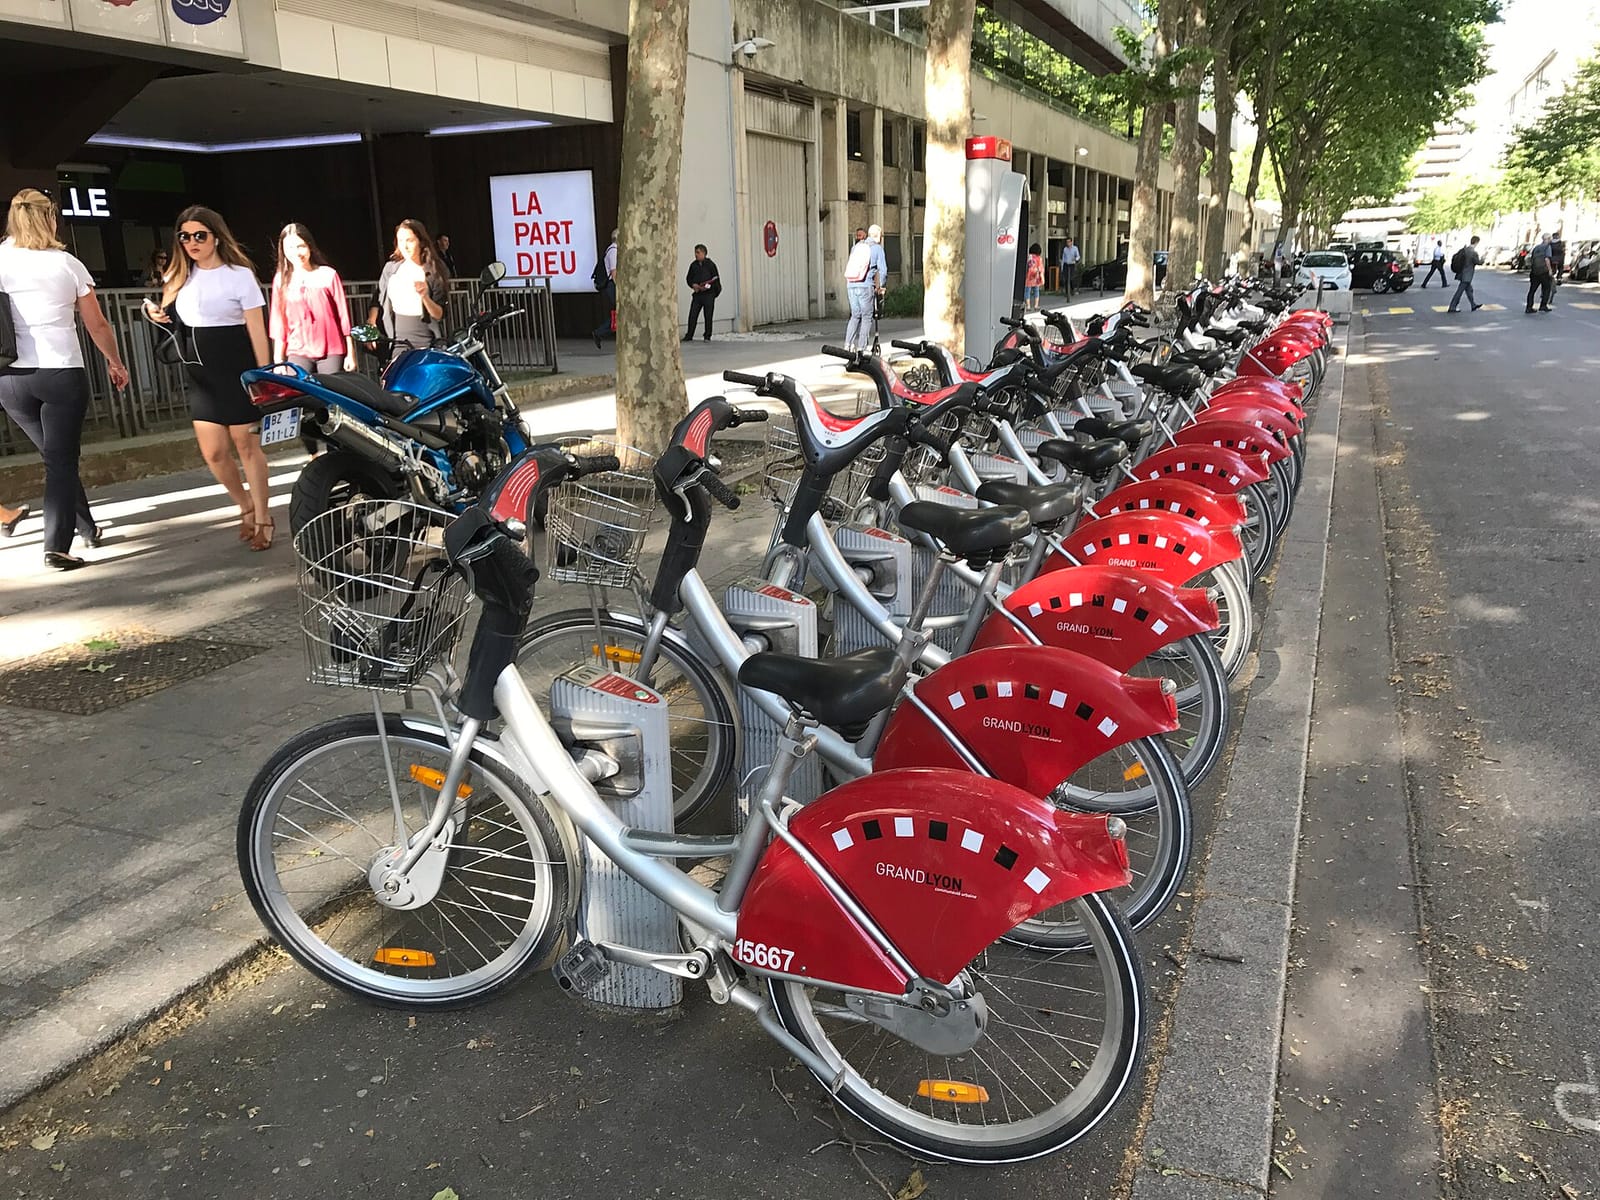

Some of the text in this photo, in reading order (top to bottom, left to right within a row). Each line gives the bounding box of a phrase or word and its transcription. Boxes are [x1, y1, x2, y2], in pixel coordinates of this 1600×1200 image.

[511, 191, 542, 216] LA
[514, 220, 573, 246] PART
[516, 250, 577, 276] DIEU
[265, 426, 295, 443] 611-LZ
[736, 938, 795, 972] 15667
